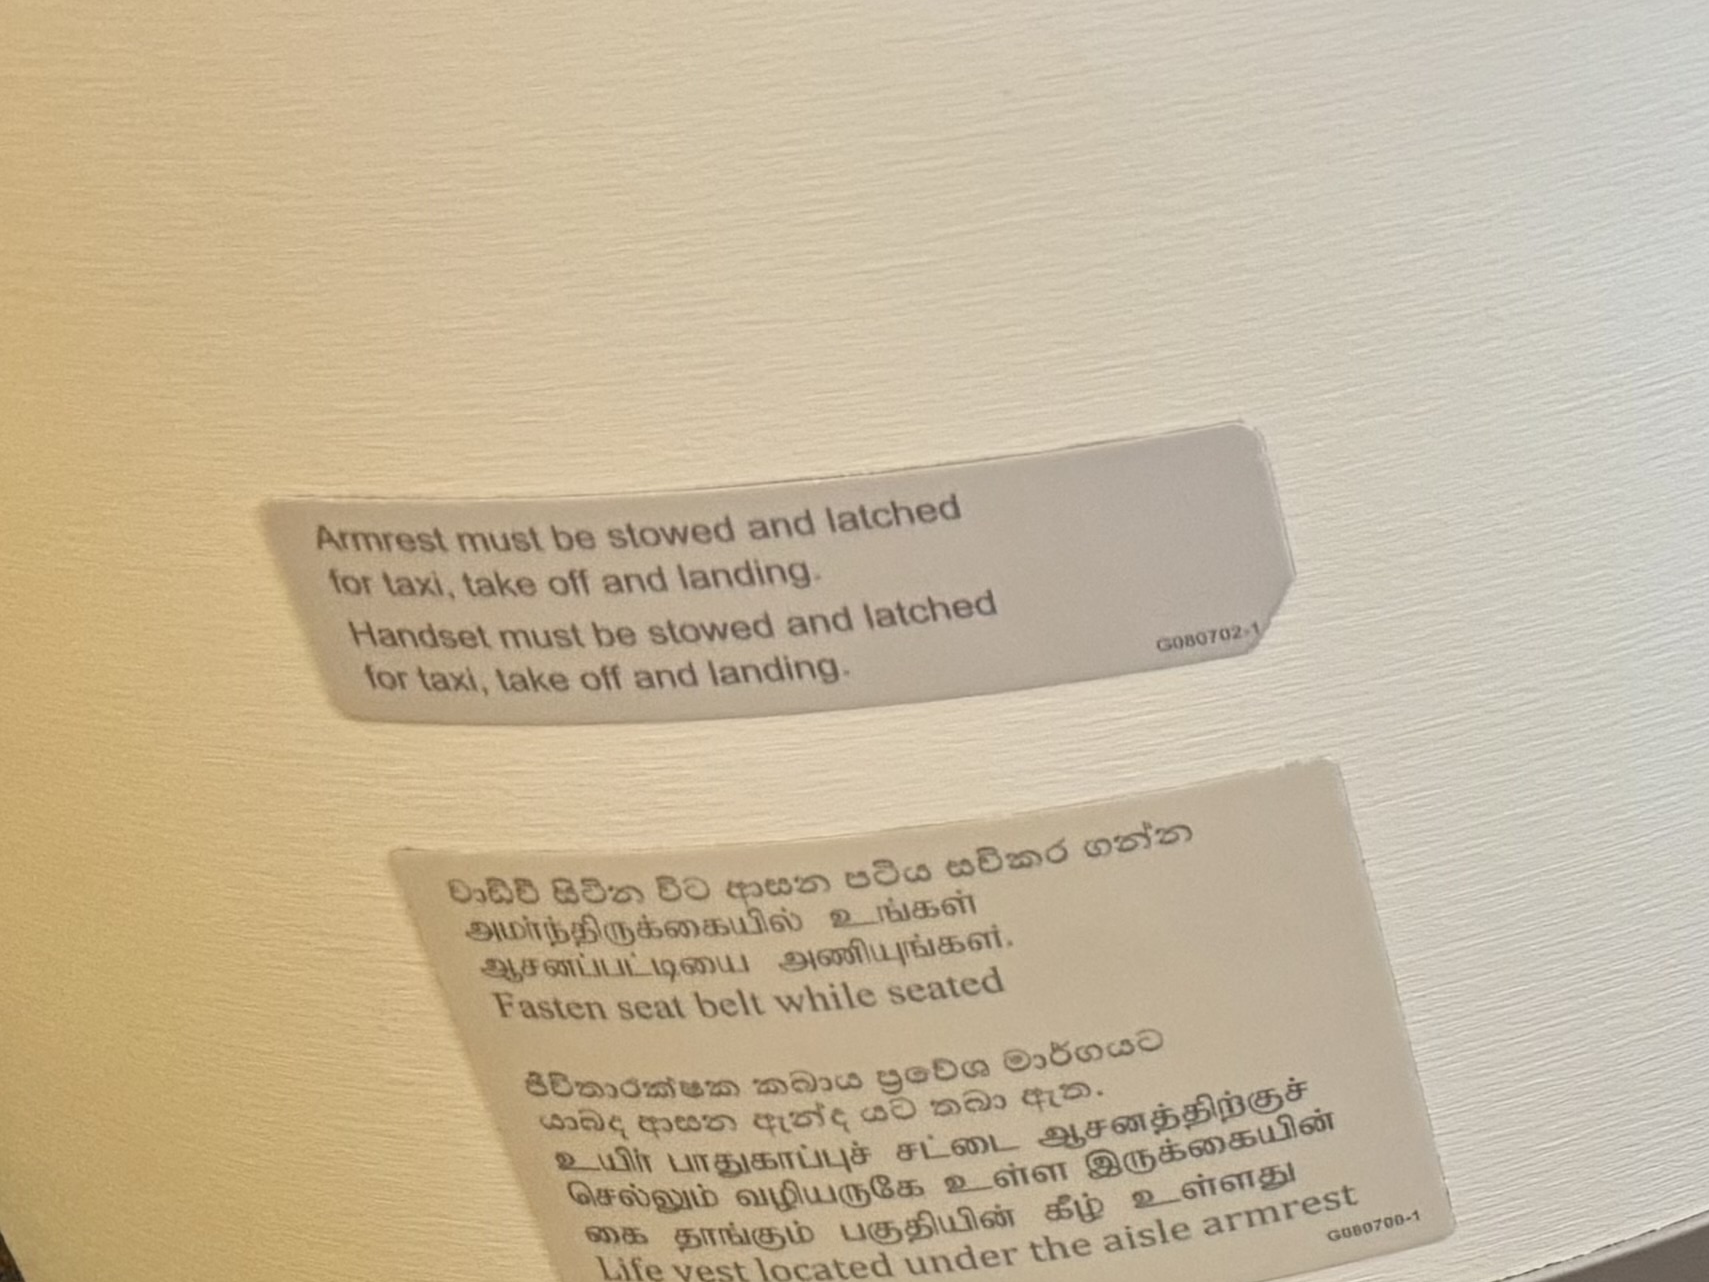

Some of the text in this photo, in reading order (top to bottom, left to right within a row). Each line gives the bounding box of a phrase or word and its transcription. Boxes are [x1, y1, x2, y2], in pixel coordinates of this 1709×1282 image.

[316, 493, 962, 553] Armrest must be stowed and latched
[329, 558, 821, 599] for taxi, take off and landing.
[348, 589, 997, 649] Handset must be stowed and latched
[1156, 621, 1260, 652] G080702-1
[364, 654, 850, 696] for taxi, take off and landing.
[492, 967, 1004, 1020] Fasten seat belt while seated
[596, 1256, 663, 1282] Life
[904, 1245, 1018, 1277] under
[1029, 1235, 1092, 1263] the
[1103, 1218, 1192, 1255] aisle
[1202, 1183, 1359, 1237] armrest
